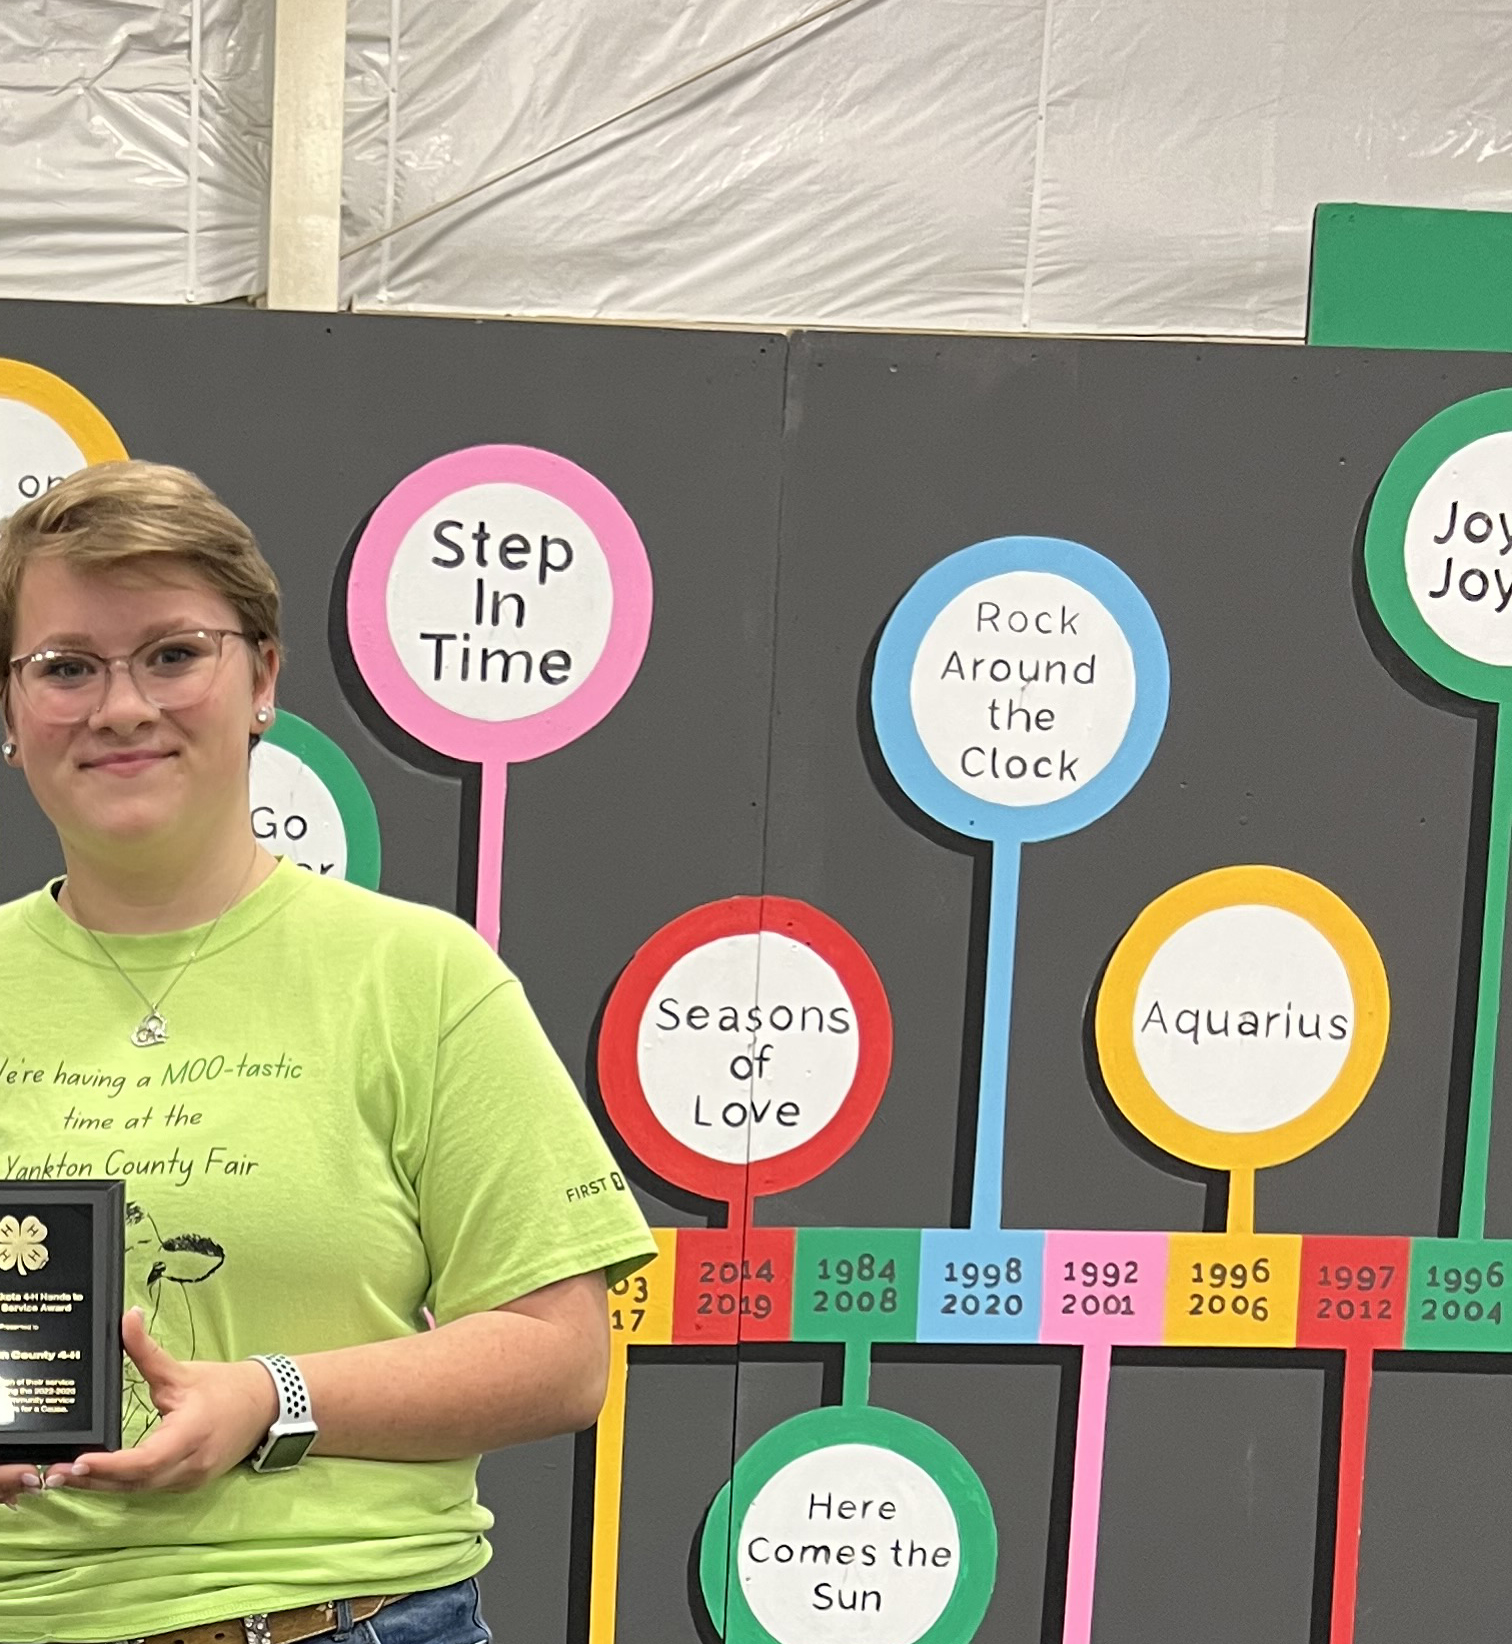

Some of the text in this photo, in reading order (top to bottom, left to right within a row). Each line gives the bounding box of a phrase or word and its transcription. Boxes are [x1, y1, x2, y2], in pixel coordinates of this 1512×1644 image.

[1433, 500, 1512, 556] Joy
[431, 520, 574, 585] Step
[1428, 557, 1512, 613] Joy
[475, 578, 526, 628] In
[977, 601, 1080, 635] Rock
[419, 632, 573, 685] Time
[940, 650, 1096, 685] Around
[987, 698, 1055, 733] the
[960, 746, 1080, 781] Clock
[251, 806, 308, 840] Go
[655, 998, 850, 1034] Seasons
[1140, 1000, 1349, 1045] Aquarius
[52, 1060, 127, 1098] having
[136, 1075, 152, 1088] a
[160, 1052, 303, 1087] MOO-tastic
[730, 1044, 774, 1080] of
[63, 1104, 203, 1130] time at the
[694, 1095, 801, 1128] Love
[4, 1146, 260, 1187] Yankton County Fair
[565, 1177, 608, 1203] FIRST
[698, 1259, 775, 1284] 2014
[817, 1253, 896, 1285] 1984
[944, 1257, 1023, 1289] 1998
[1064, 1260, 1139, 1288] 1992
[1191, 1258, 1270, 1289] 1996
[1318, 1266, 1395, 1291] 1997
[1426, 1261, 1505, 1294] 1996
[1, 1303, 38, 1313] Service
[40, 1303, 72, 1313] Award
[696, 1293, 772, 1319] 2019
[813, 1287, 898, 1314] 2008
[940, 1294, 1024, 1316] 2020
[1061, 1294, 1136, 1316] 2001
[1187, 1294, 1269, 1321] 2006
[1316, 1299, 1393, 1320] 2012
[1421, 1299, 1502, 1326] 2004
[10, 1350, 56, 1362] County
[808, 1492, 897, 1520] Here
[747, 1536, 952, 1568] Comes the
[812, 1582, 882, 1612] Sun
